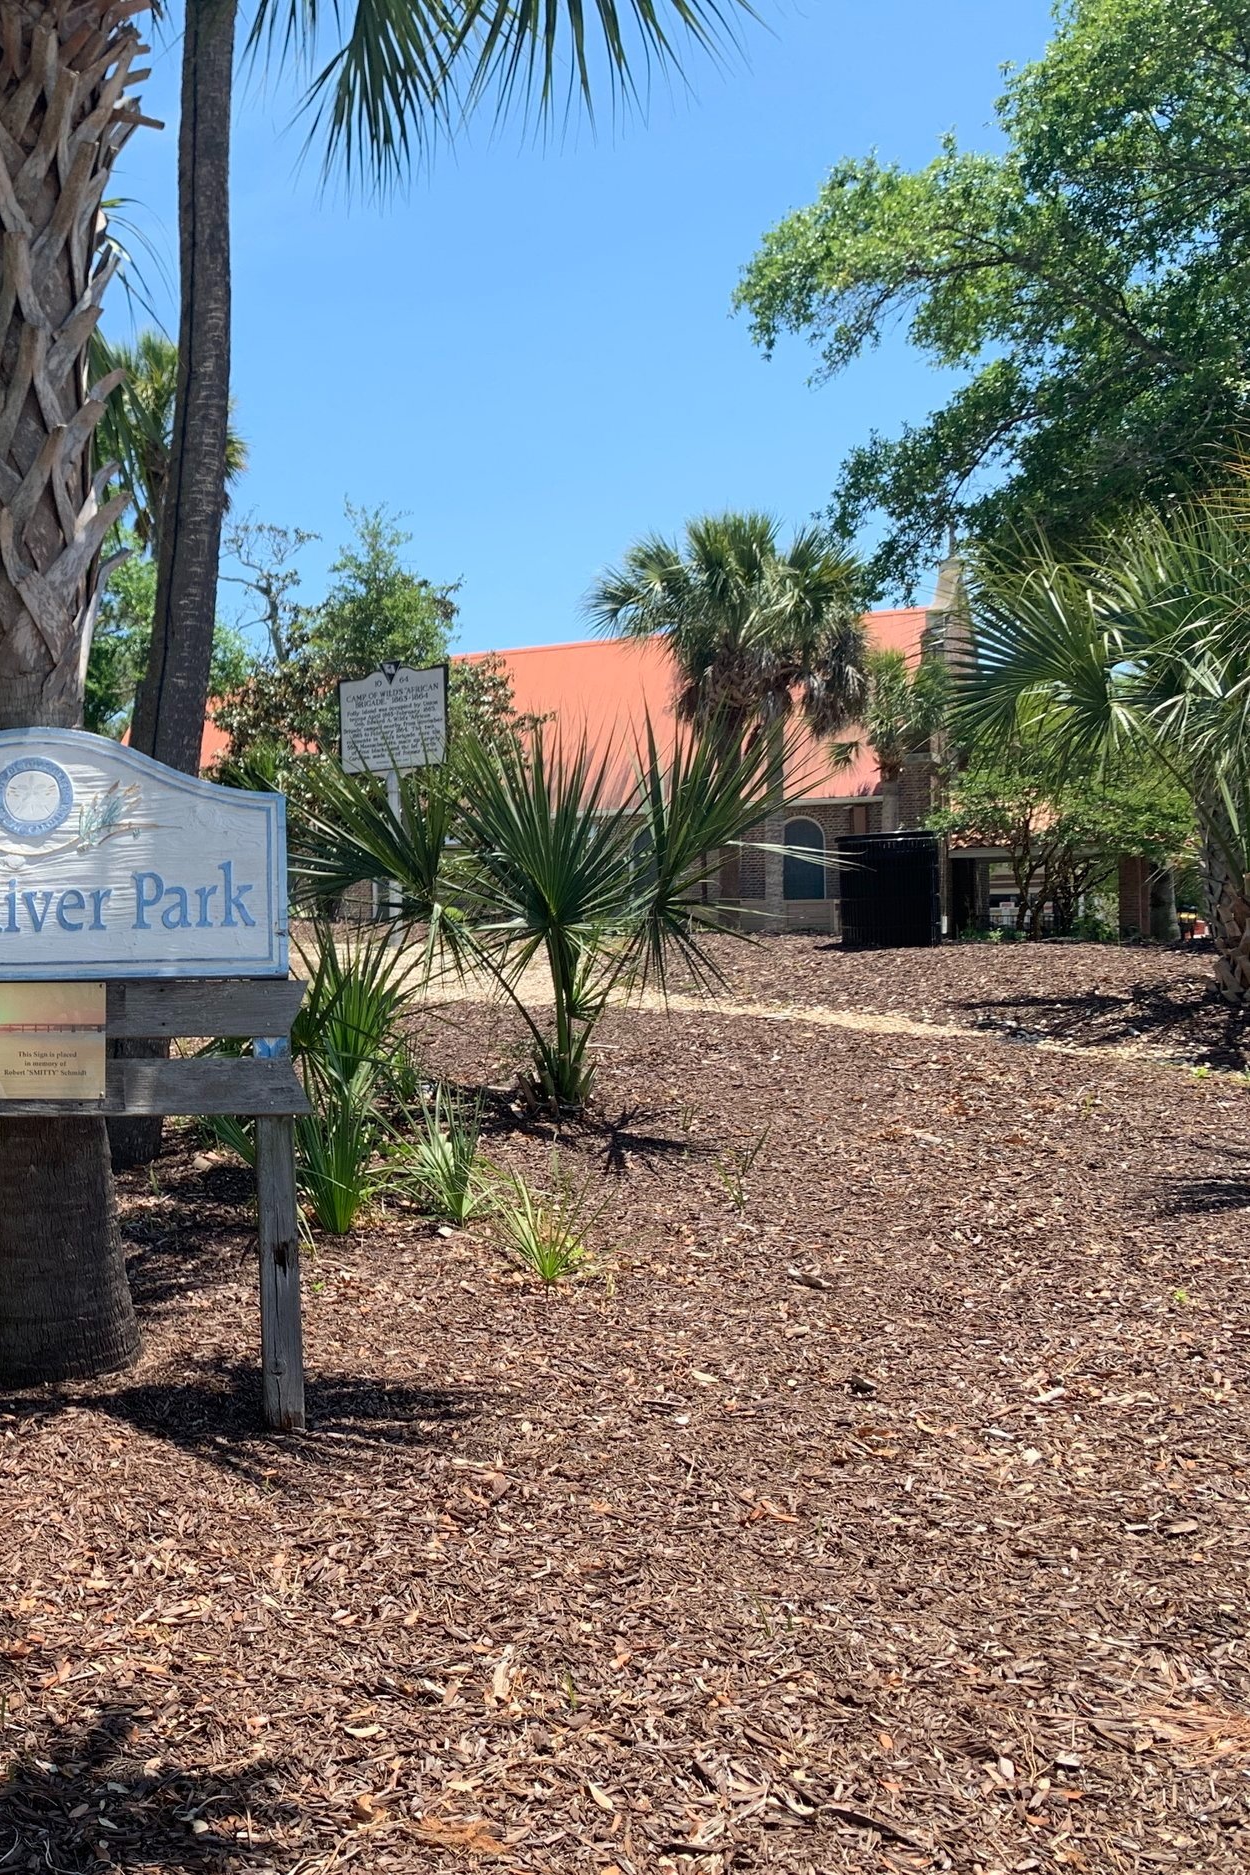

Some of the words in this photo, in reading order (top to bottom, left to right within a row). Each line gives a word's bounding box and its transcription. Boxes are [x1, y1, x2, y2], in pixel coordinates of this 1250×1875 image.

[346, 693, 367, 703] CAMP
[133, 860, 256, 930] Park
[33, 1051, 48, 1059] Sign
[57, 1051, 77, 1059] placed
